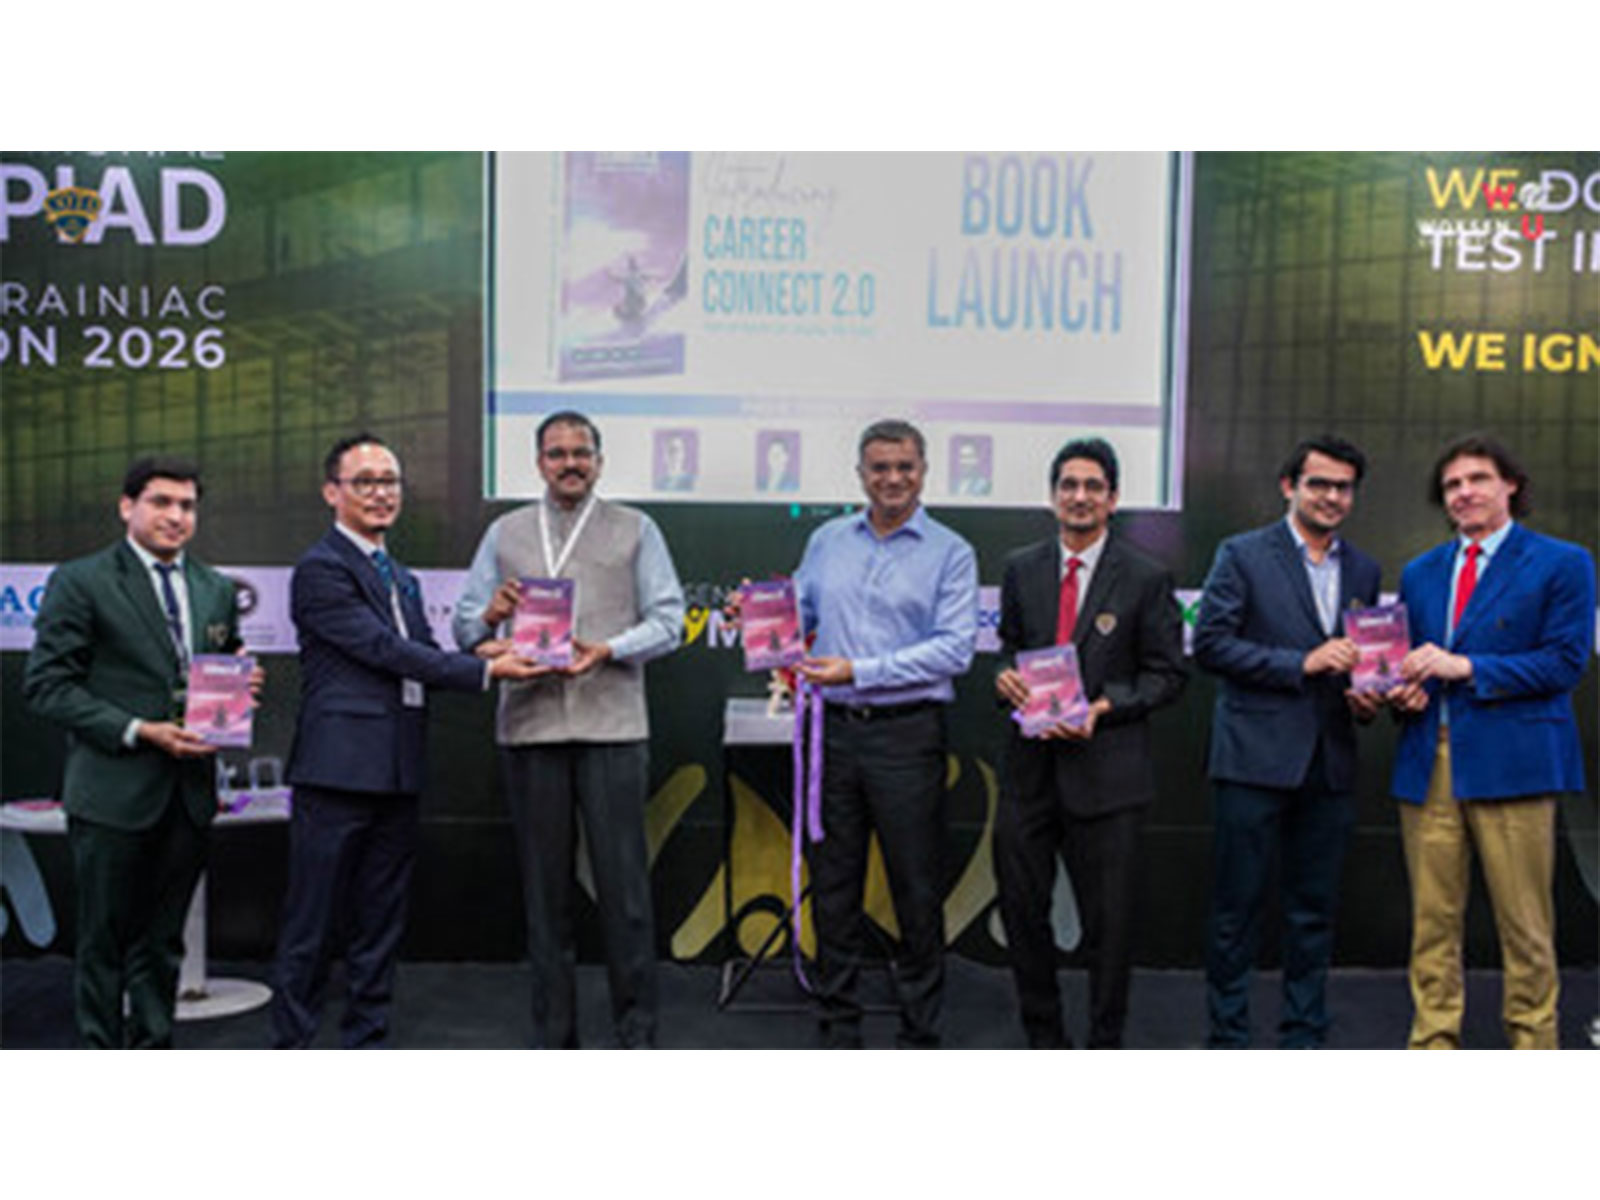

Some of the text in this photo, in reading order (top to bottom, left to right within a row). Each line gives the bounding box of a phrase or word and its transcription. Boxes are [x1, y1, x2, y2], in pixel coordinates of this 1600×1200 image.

[961, 155, 1094, 240] BOOK
[703, 213, 806, 261] CAREER
[1427, 228, 1557, 272] TEST
[703, 268, 876, 317] CONNECT 2.0
[926, 248, 1121, 333] LAUNCH
[83, 327, 225, 369] 2026
[1418, 331, 1506, 370] WE
